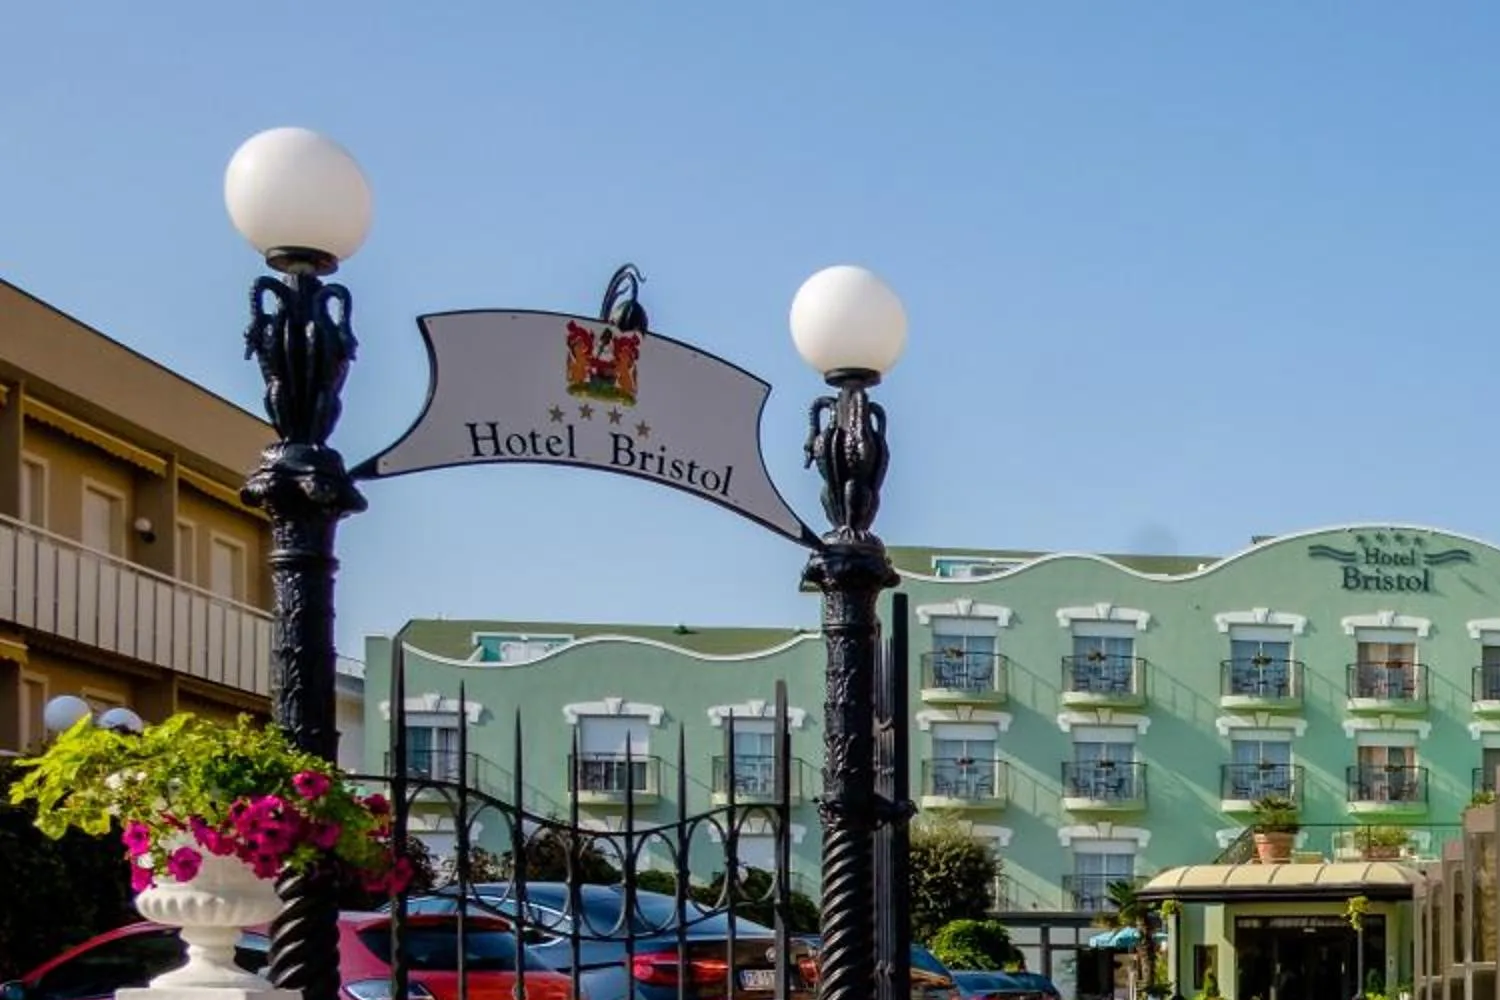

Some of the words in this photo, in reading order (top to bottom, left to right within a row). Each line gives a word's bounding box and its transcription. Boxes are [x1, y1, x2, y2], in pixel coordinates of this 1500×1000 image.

[465, 422, 576, 458] Hotel
[609, 432, 733, 497] Bristol
[1364, 547, 1416, 566] Hotel
[1341, 565, 1431, 593] Bristol
